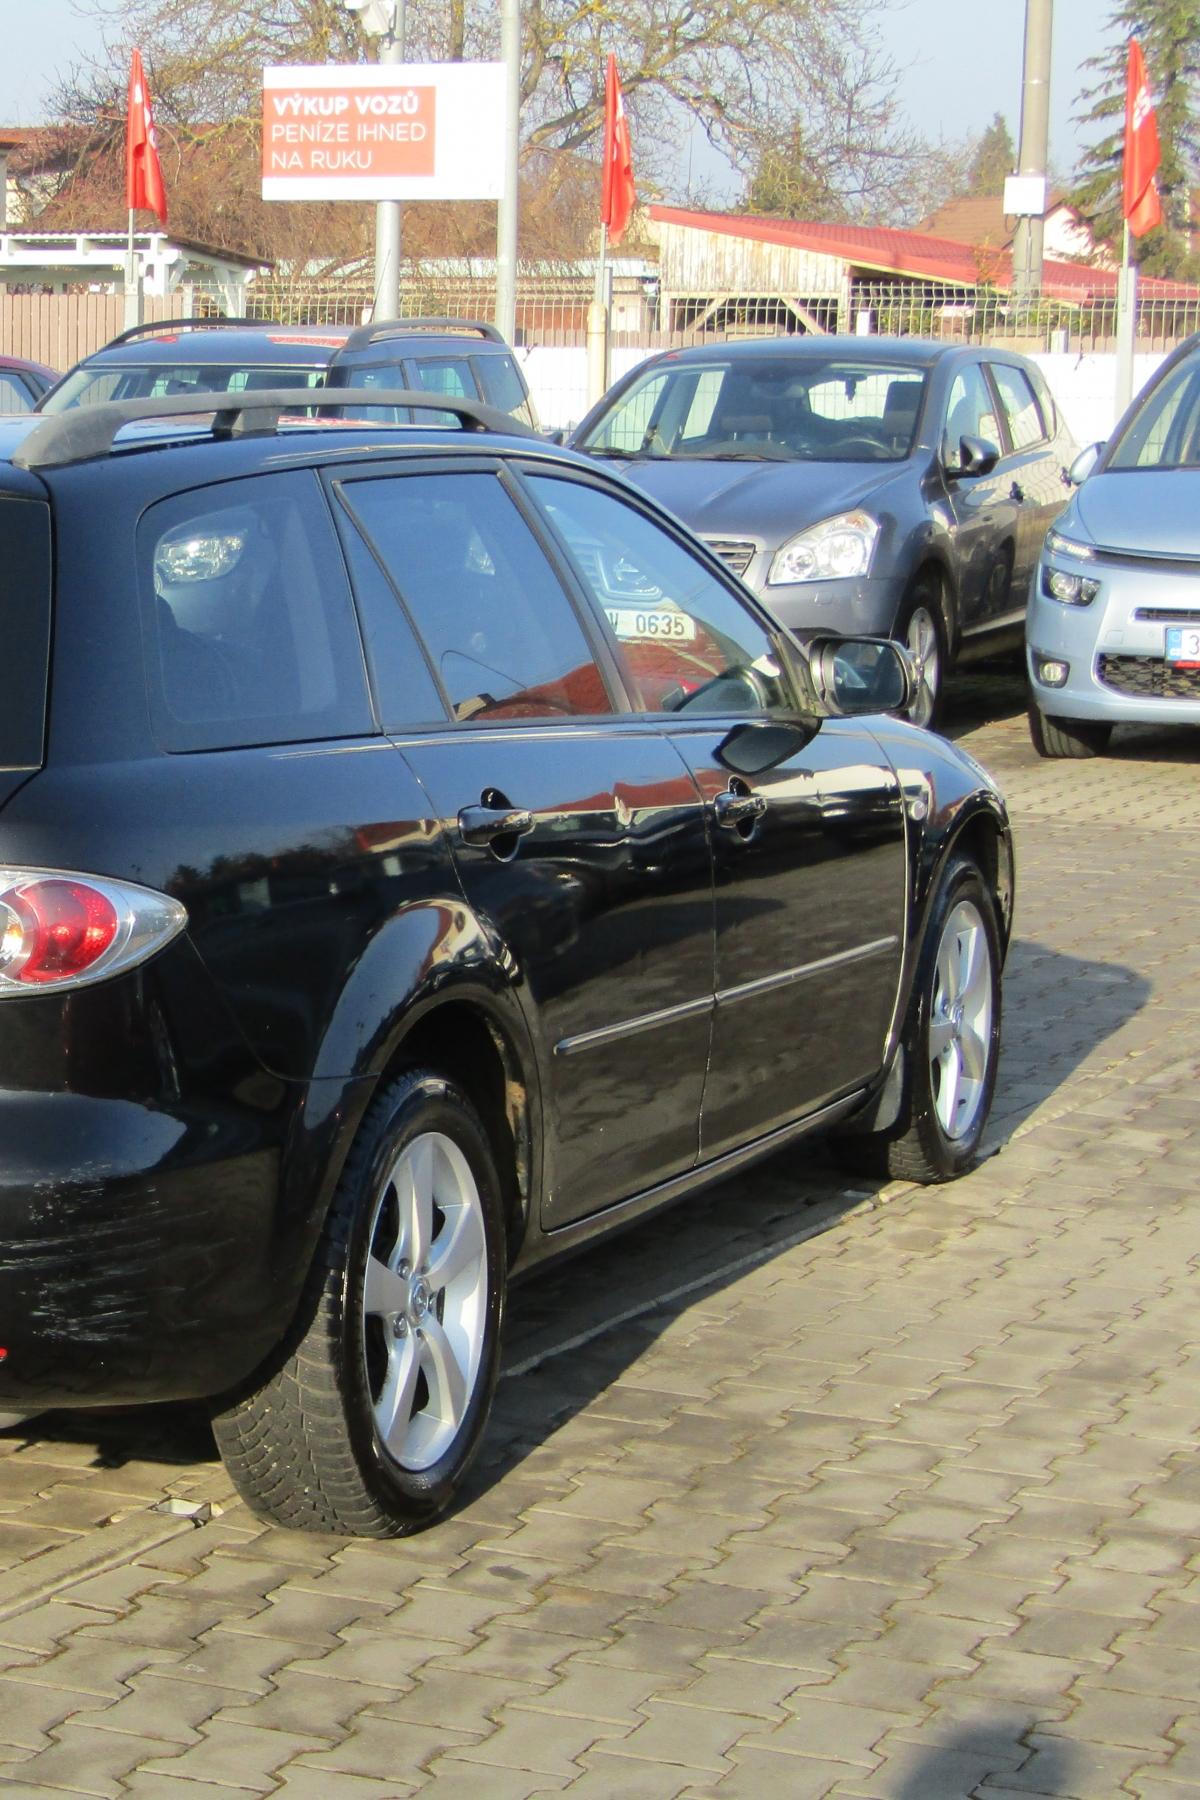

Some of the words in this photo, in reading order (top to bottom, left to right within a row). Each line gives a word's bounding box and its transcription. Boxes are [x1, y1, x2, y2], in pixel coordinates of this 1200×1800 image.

[273, 93, 349, 116] VÝKUP
[355, 90, 419, 115] VOZŮ
[271, 121, 349, 143] PENÍZE
[357, 123, 426, 142] IHNED
[271, 151, 304, 169] NA
[311, 151, 372, 169] RUKU
[635, 614, 685, 636] 0635
